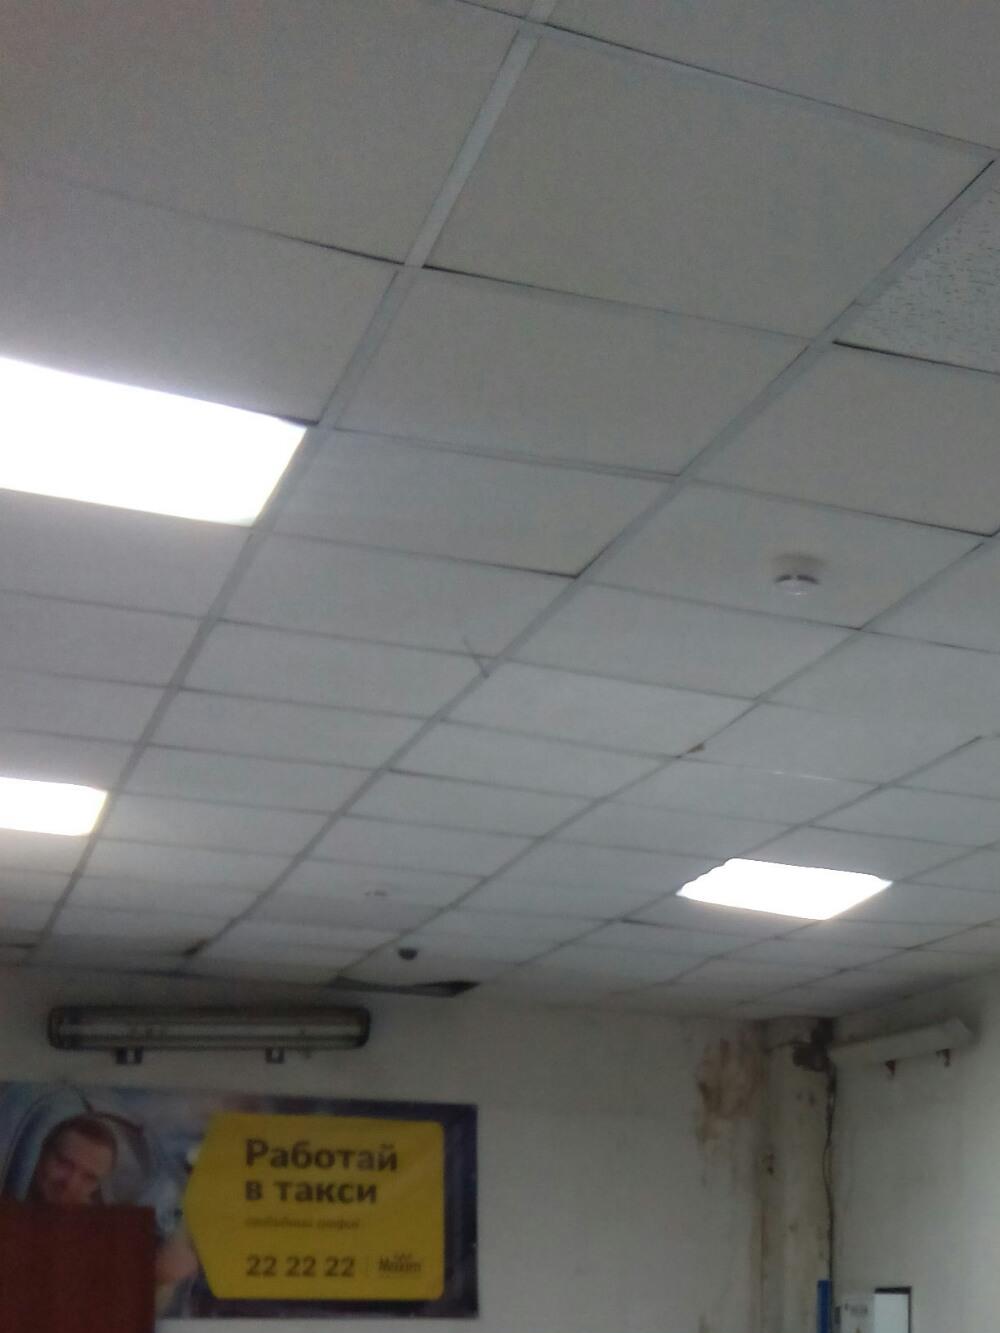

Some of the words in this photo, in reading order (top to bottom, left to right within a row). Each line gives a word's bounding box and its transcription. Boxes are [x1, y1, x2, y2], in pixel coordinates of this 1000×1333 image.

[245, 1137, 398, 1171] Работай
[245, 1180, 263, 1201] в
[274, 1181, 378, 1204] такси
[246, 1255, 277, 1278] 22
[285, 1255, 317, 1278] 22
[324, 1255, 356, 1278] 22
